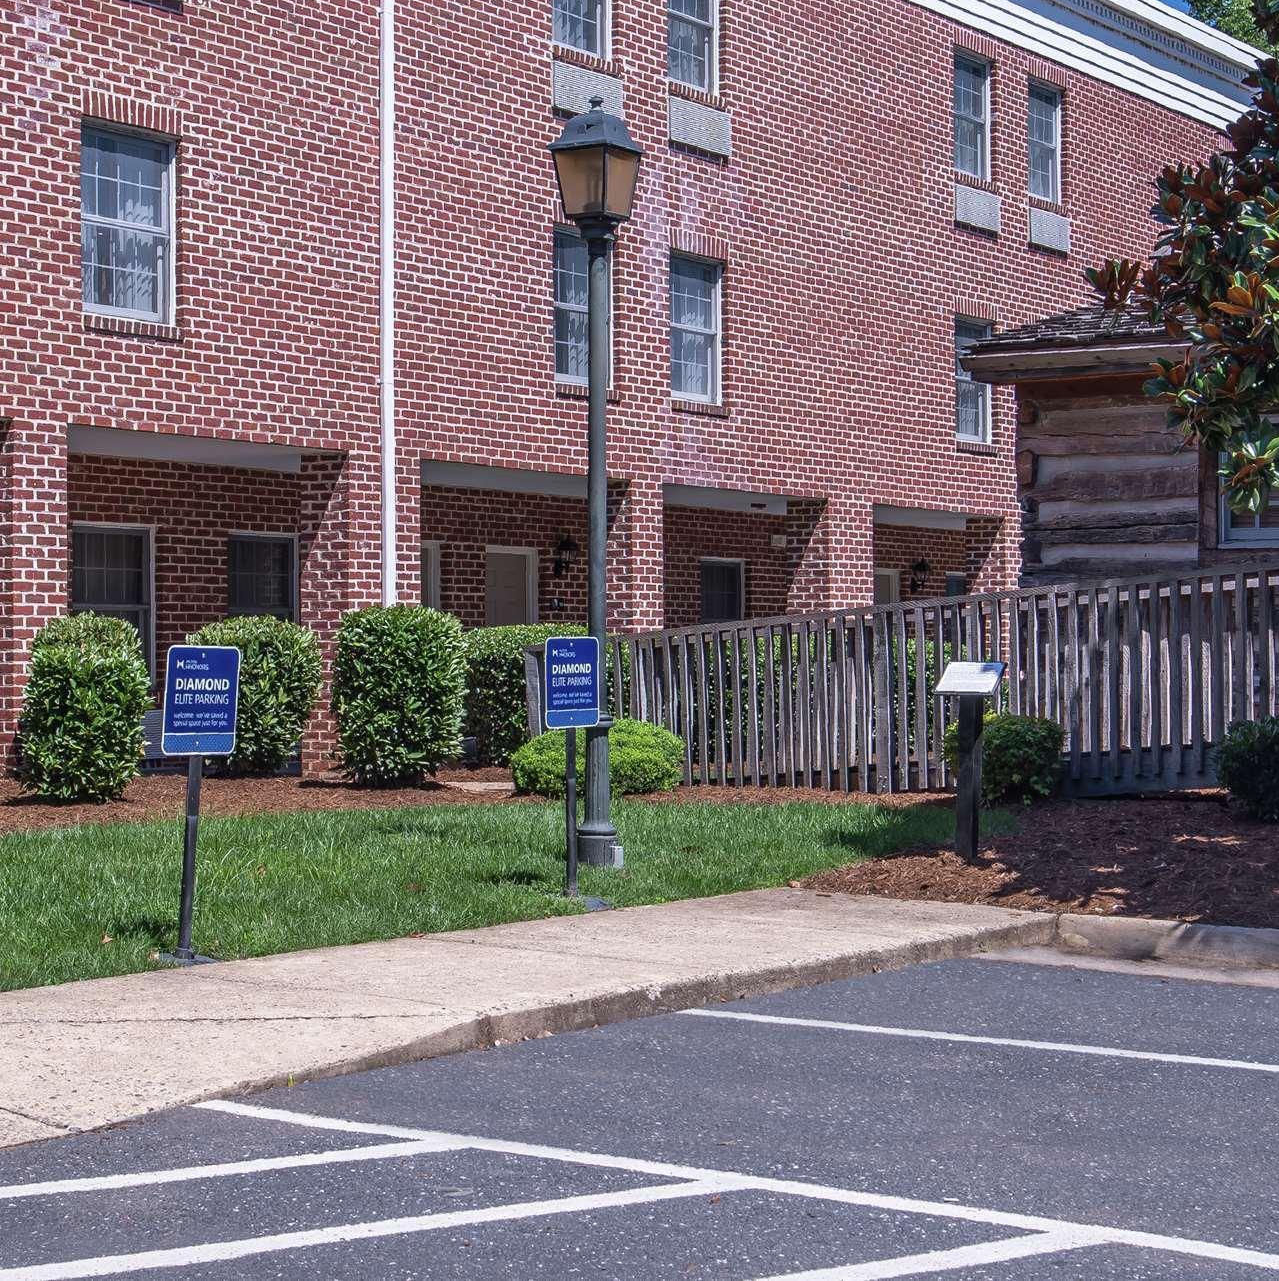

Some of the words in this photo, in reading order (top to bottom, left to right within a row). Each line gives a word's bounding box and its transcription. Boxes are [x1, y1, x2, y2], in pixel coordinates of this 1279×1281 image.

[552, 663, 592, 675] DIAMOND
[175, 678, 230, 691] DIAMOND
[552, 677, 566, 687] ELITE
[567, 676, 592, 687] PARKING
[174, 693, 193, 705] ELITE
[194, 693, 229, 705] PARKING
